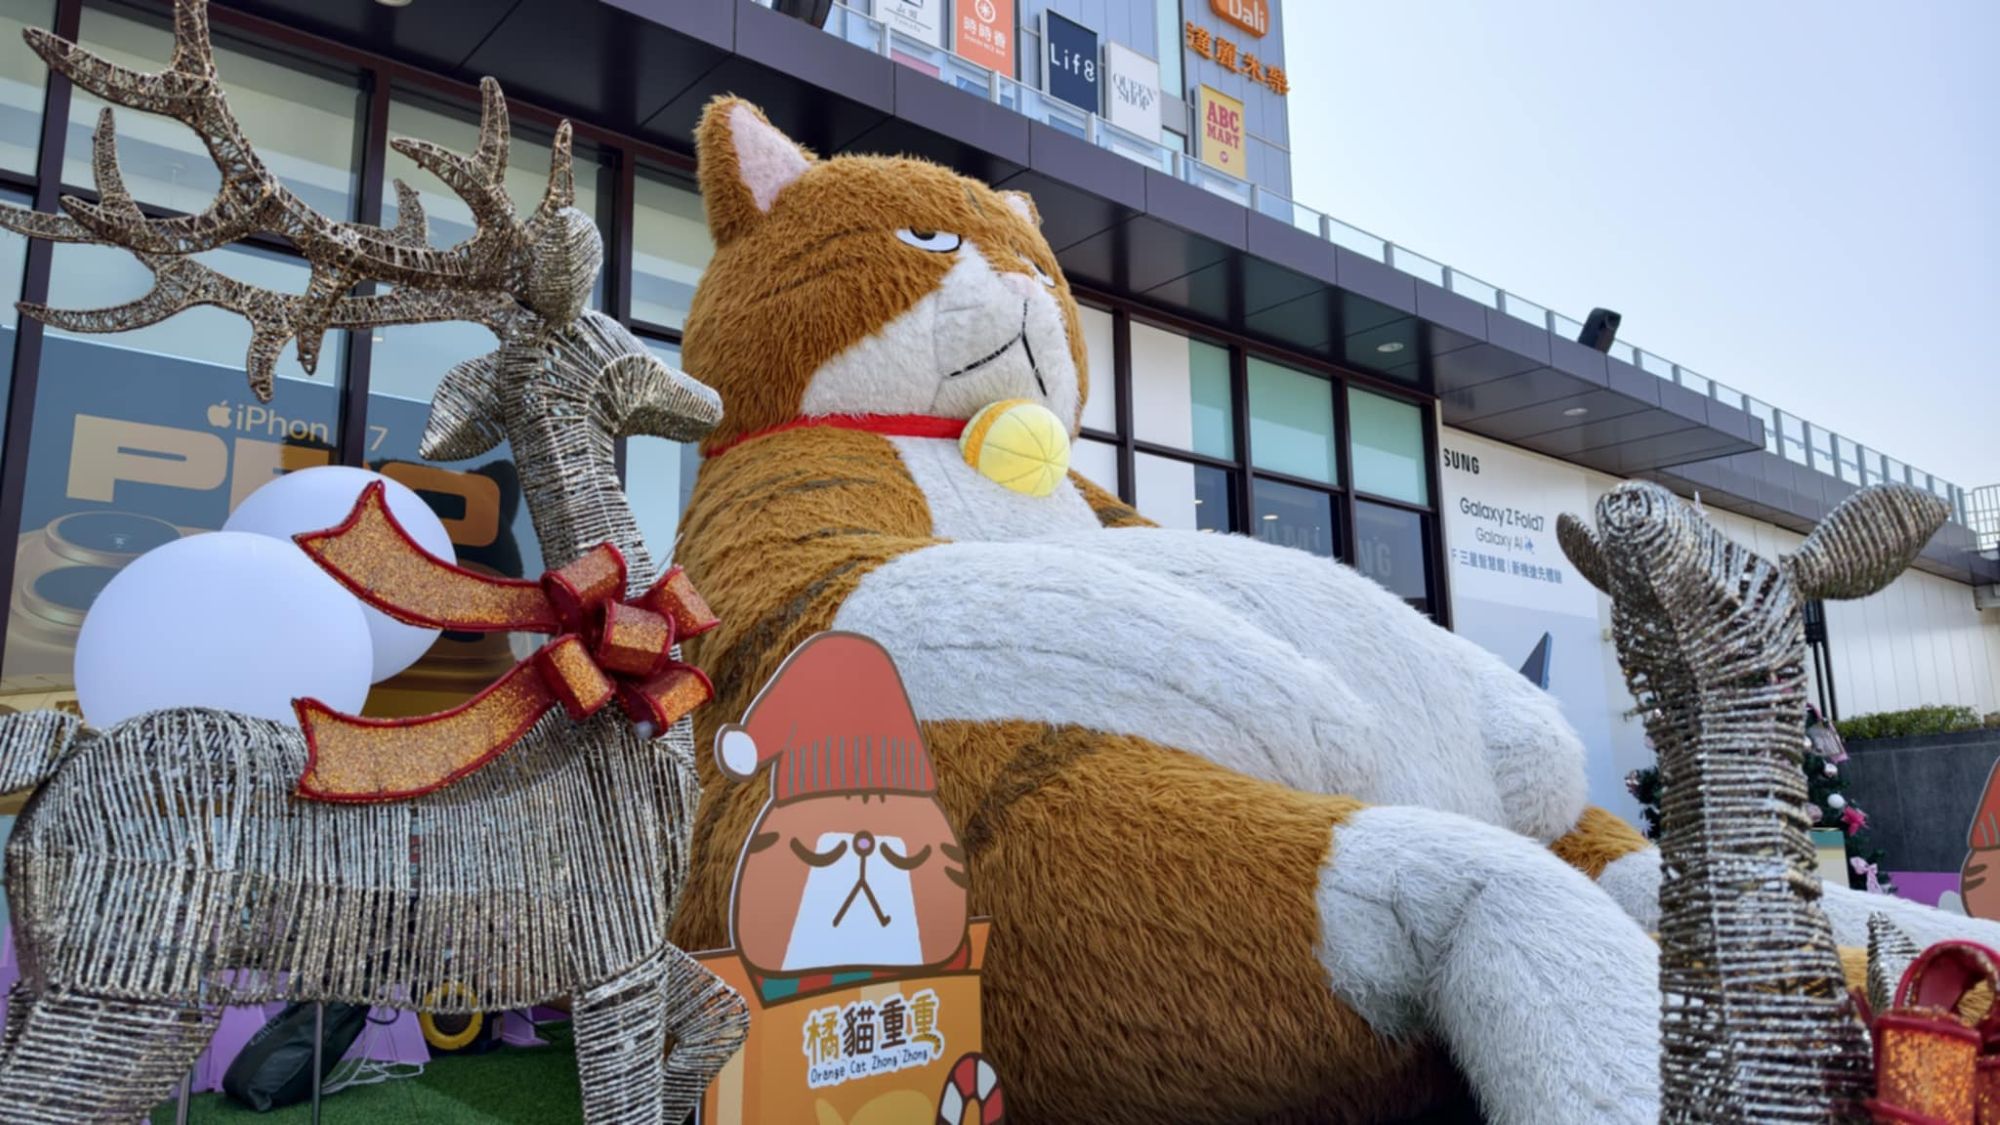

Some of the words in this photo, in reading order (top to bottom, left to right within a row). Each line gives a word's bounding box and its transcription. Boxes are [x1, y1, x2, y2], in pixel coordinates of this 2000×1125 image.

[1229, 0, 1265, 34] Dali
[1207, 100, 1240, 133] ABC
[1207, 123, 1240, 149] MART
[236, 404, 329, 443] iPhon
[1443, 448, 1480, 475] SUNG
[1460, 497, 1504, 527] Galaxy
[1506, 508, 1513, 525] Z
[1514, 510, 1544, 532] Fold7
[1475, 527, 1511, 551] Galaxy
[806, 994, 942, 1067] 橘貓重重
[811, 1065, 846, 1084] Orange
[850, 1060, 867, 1074] Cat
[871, 1055, 898, 1070] Zhong
[902, 1049, 928, 1064] Zhong
